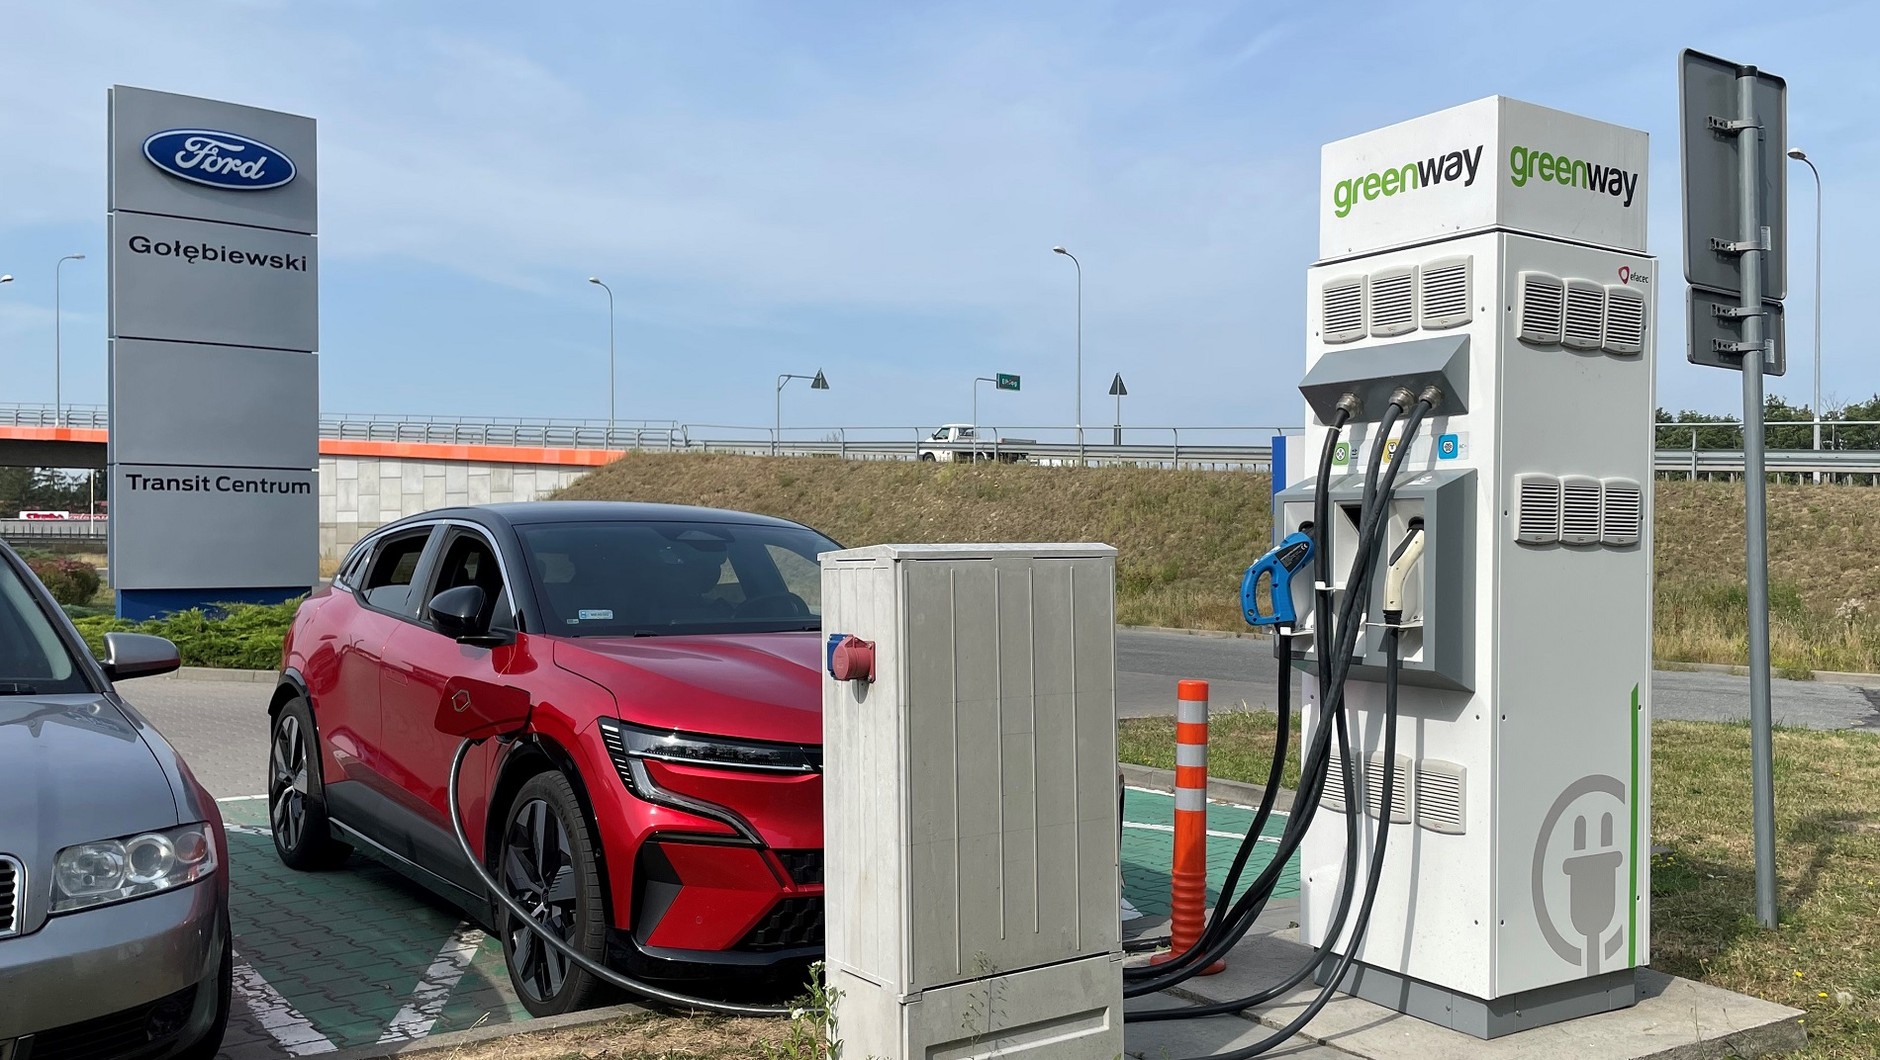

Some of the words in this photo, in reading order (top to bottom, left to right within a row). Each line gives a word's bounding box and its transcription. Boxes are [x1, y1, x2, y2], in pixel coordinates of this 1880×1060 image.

[175, 136, 267, 180] Ford
[1509, 144, 1639, 208] greenway
[1334, 144, 1484, 219] greenway
[128, 235, 308, 273] Gołębiewski
[1630, 271, 1649, 284] efacec
[125, 473, 211, 492] Transit
[215, 475, 312, 495] Centrum
